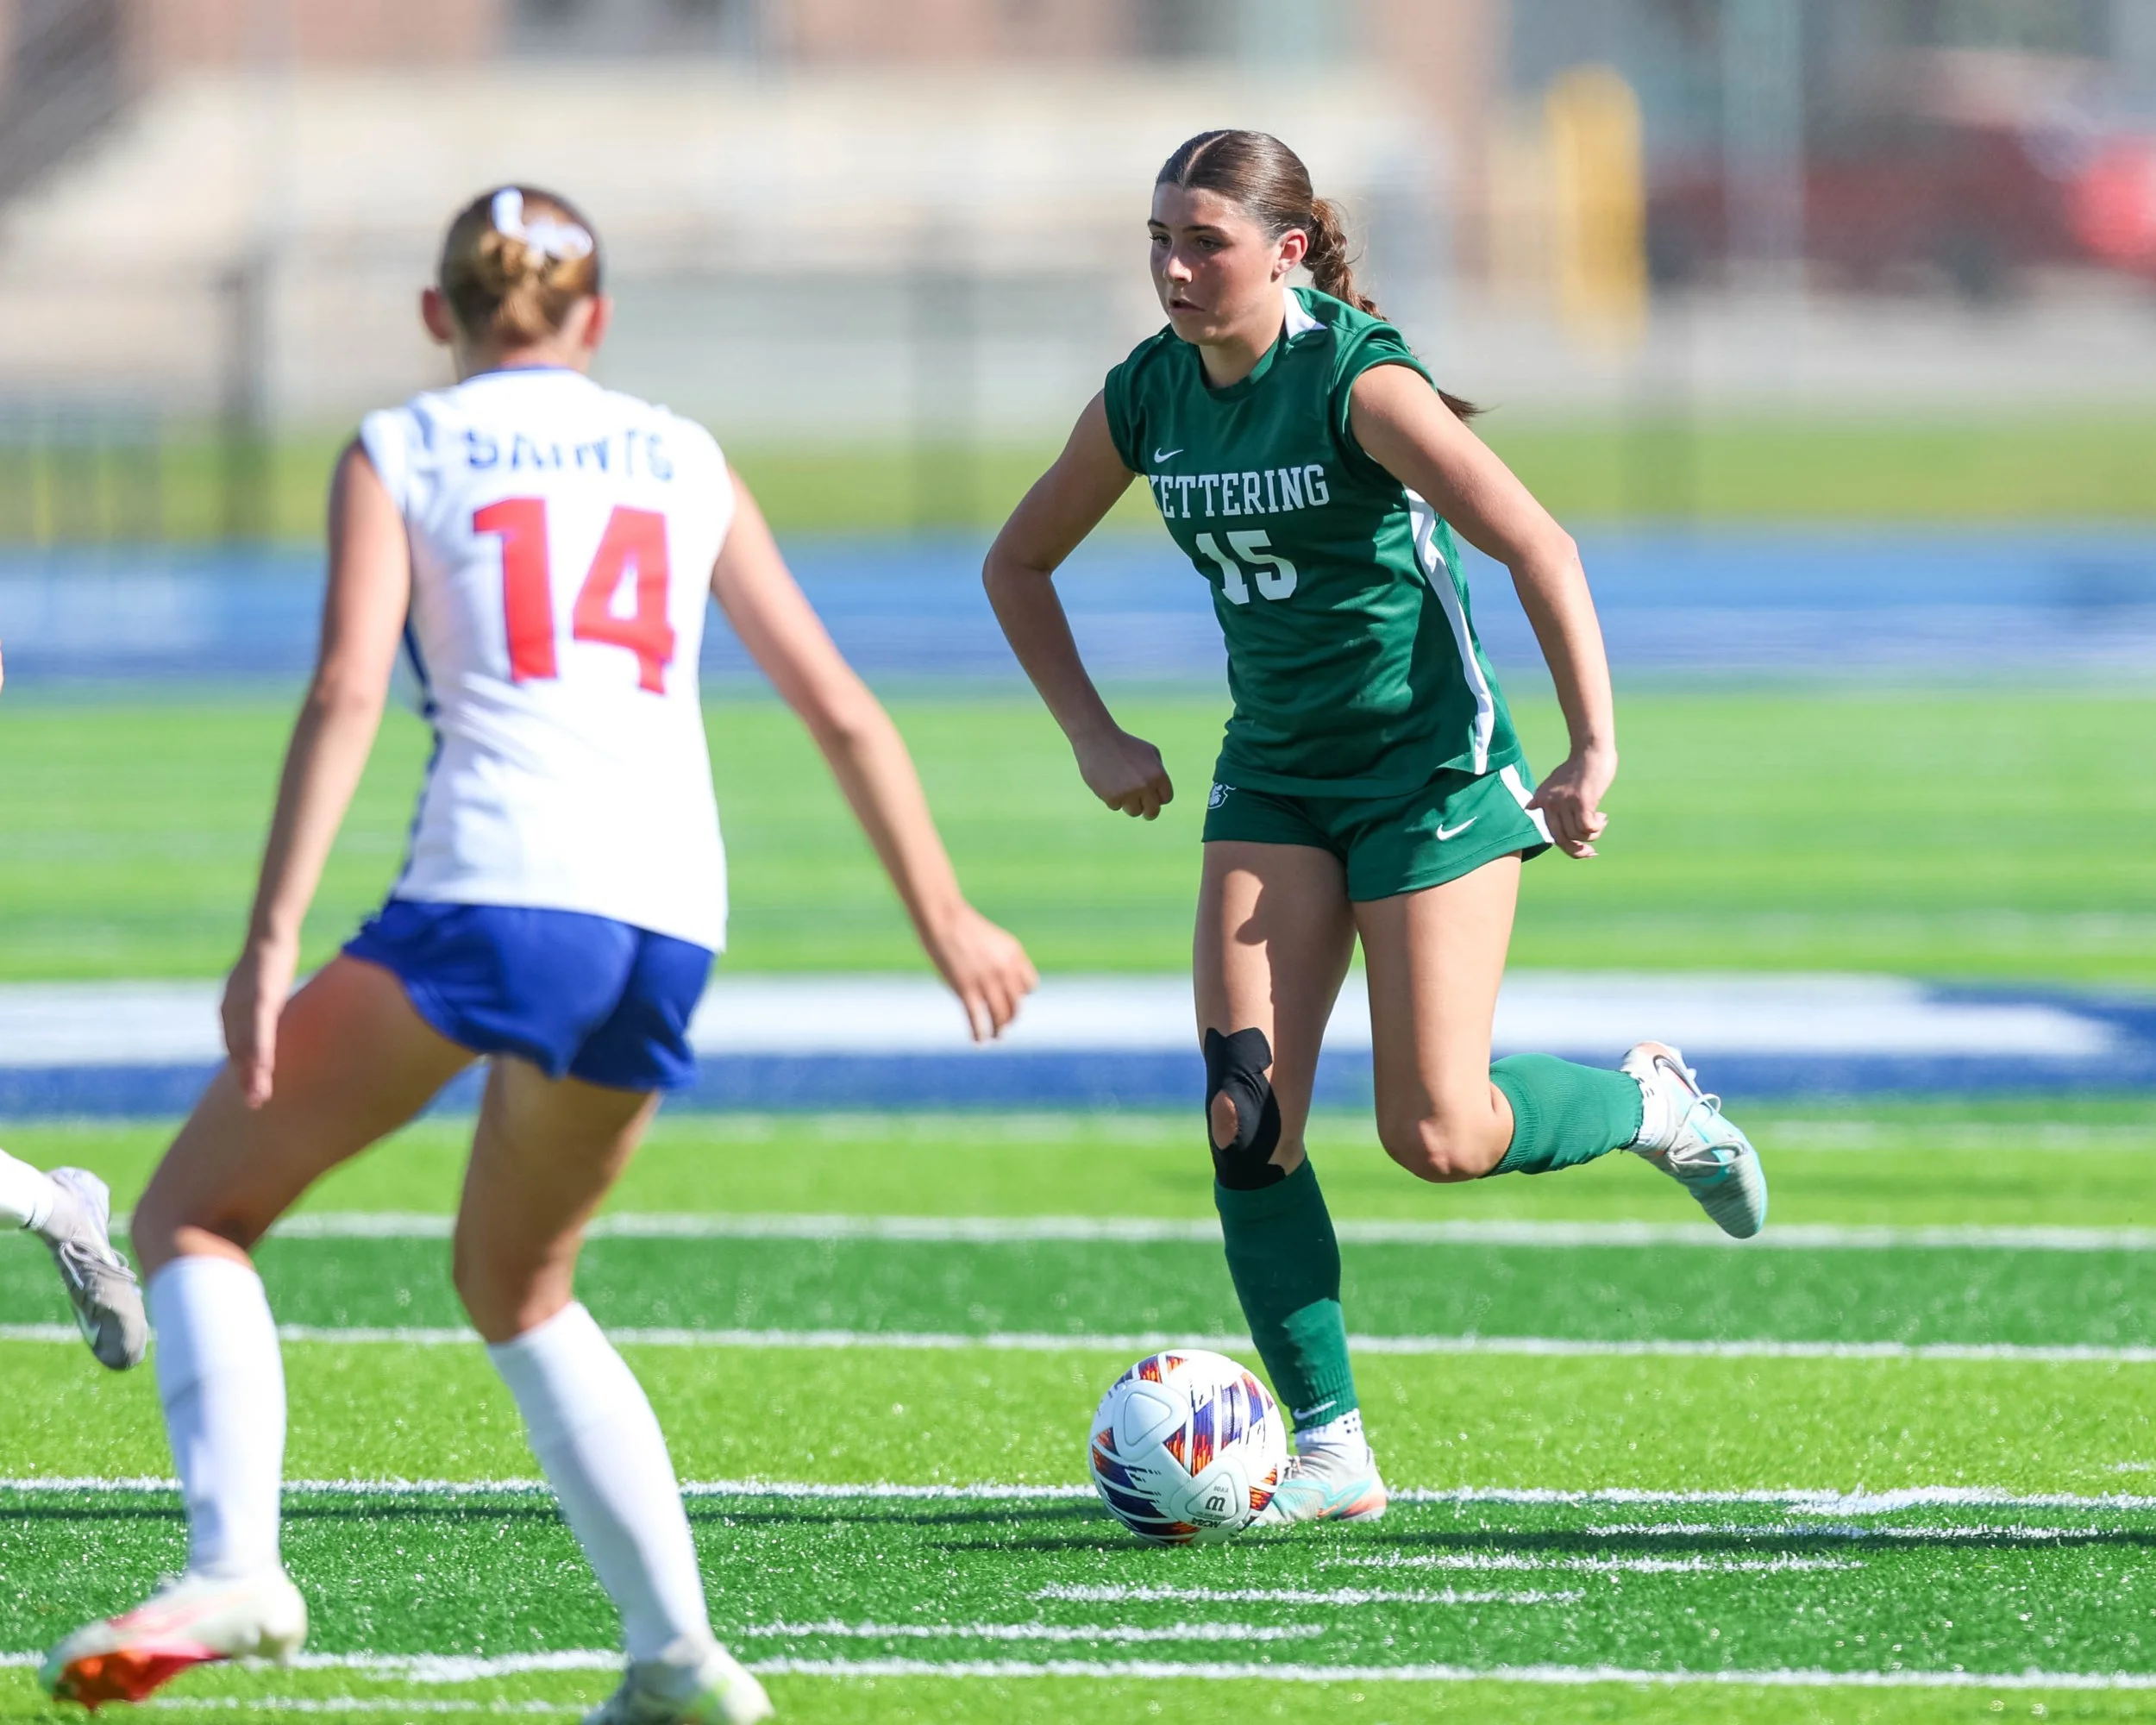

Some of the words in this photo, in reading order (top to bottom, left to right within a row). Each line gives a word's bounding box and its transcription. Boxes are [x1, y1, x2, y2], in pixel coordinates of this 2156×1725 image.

[463, 427, 674, 481] SAINTS
[473, 497, 676, 695] 14
[1195, 530, 1297, 605] 15
